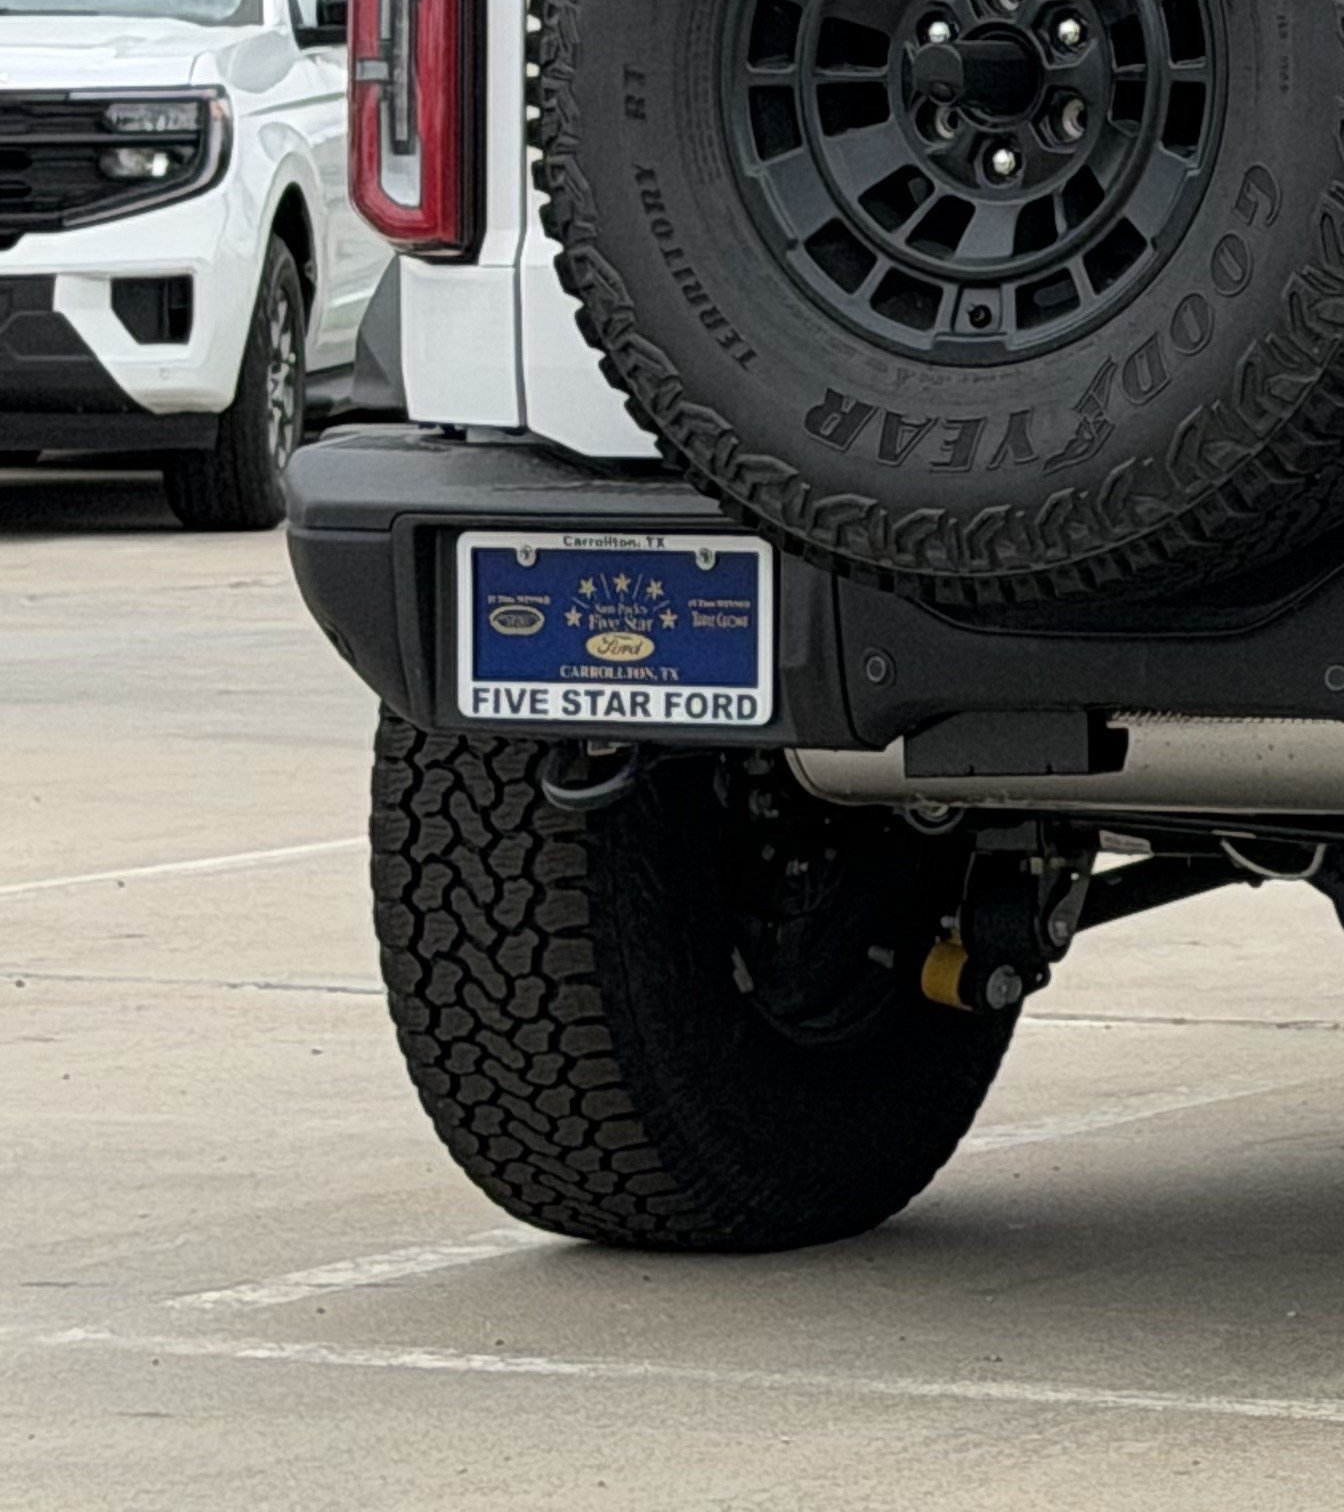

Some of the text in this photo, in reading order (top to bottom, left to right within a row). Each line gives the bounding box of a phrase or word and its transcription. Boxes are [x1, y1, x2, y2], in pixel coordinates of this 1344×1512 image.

[631, 163, 759, 372] TERRITORY
[597, 635, 643, 655] Ford
[472, 687, 758, 721] FIVE STAR FORD
